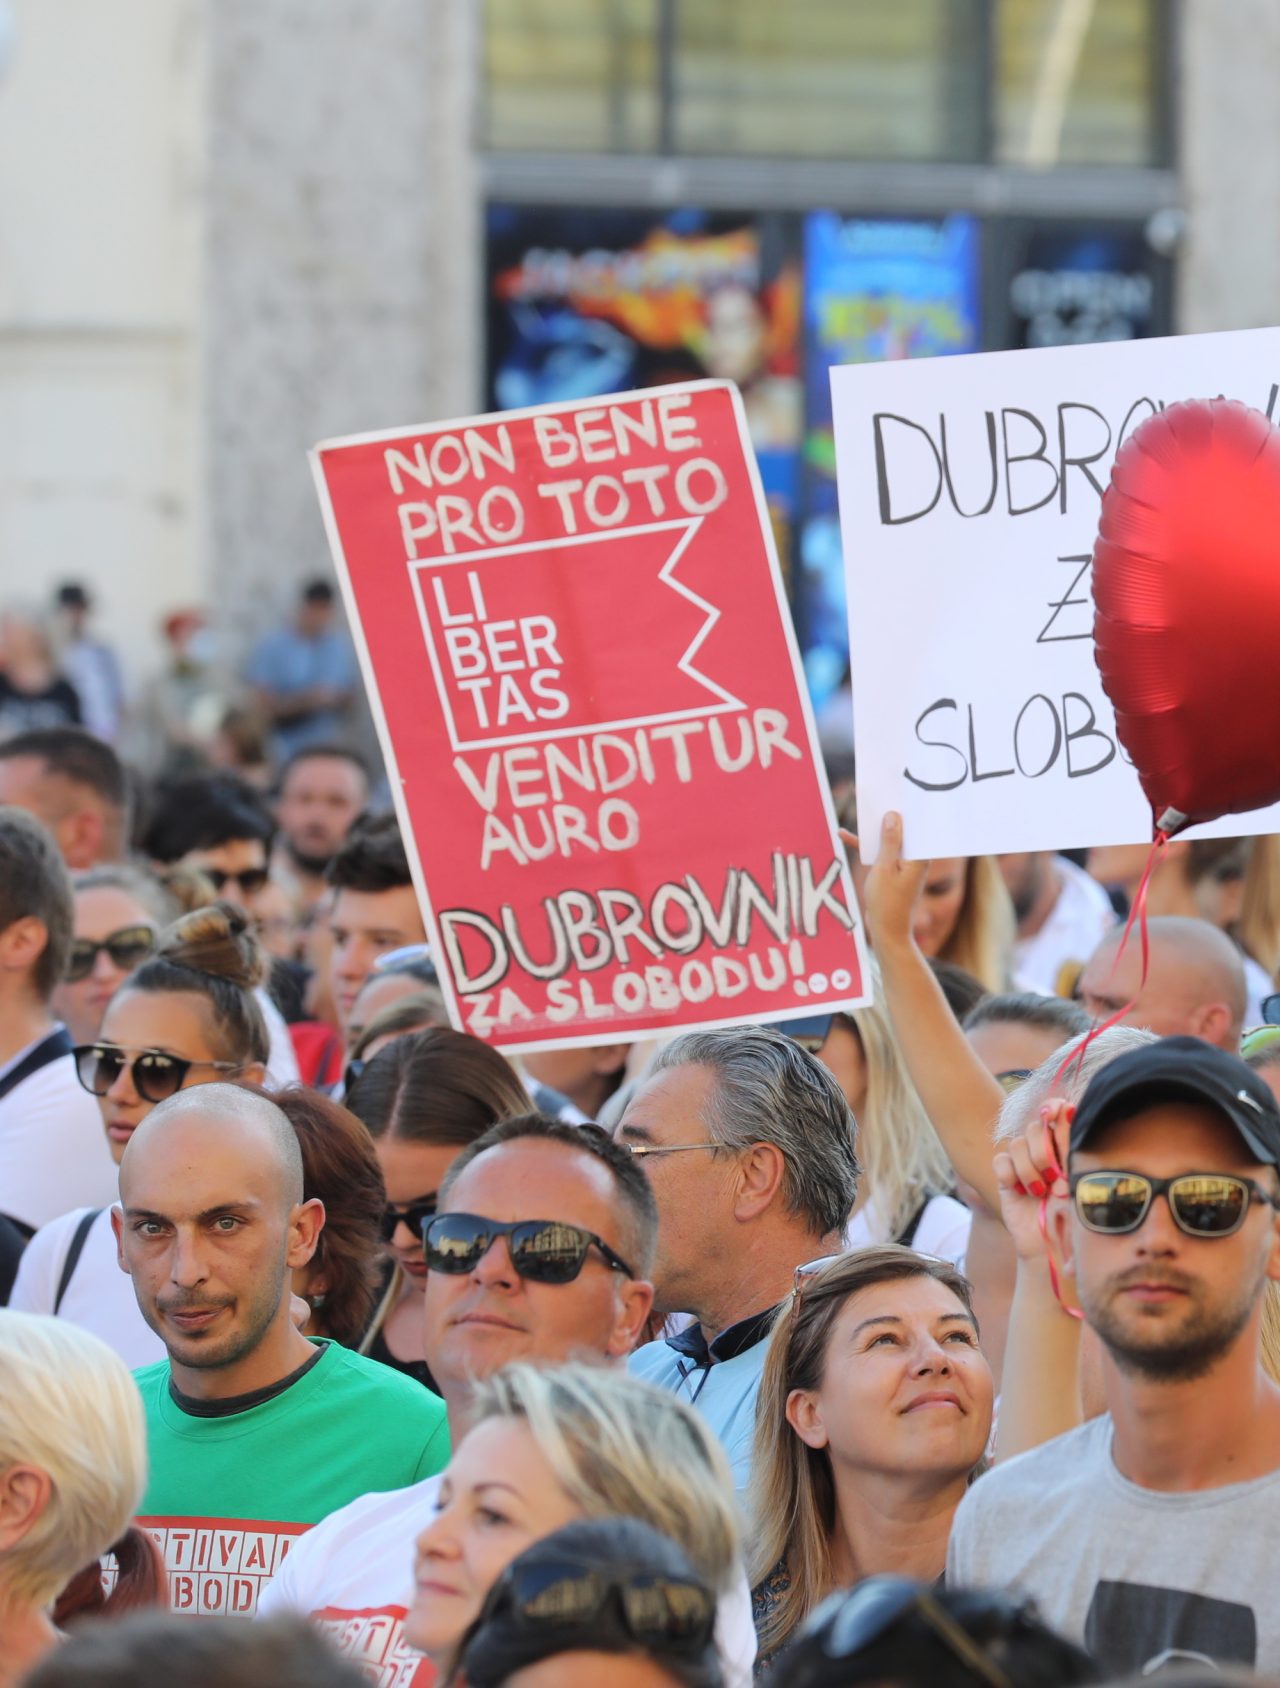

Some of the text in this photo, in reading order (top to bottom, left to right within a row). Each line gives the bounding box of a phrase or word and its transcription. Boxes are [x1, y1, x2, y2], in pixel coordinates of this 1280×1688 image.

[384, 393, 703, 494] NON BENE
[396, 456, 728, 559] PRO TOTO
[432, 571, 488, 626] LI
[1037, 553, 1094, 643] Z
[444, 615, 564, 679] BER
[457, 668, 570, 728] TAS
[454, 708, 802, 810] VENDITUR
[904, 692, 1134, 792] SLOB
[480, 798, 641, 871] AURO
[438, 846, 856, 995] DUBROVNIK
[462, 990, 534, 1038] ZA
[149, 1532, 292, 1569] TIVA
[174, 1577, 254, 1612] BOD
